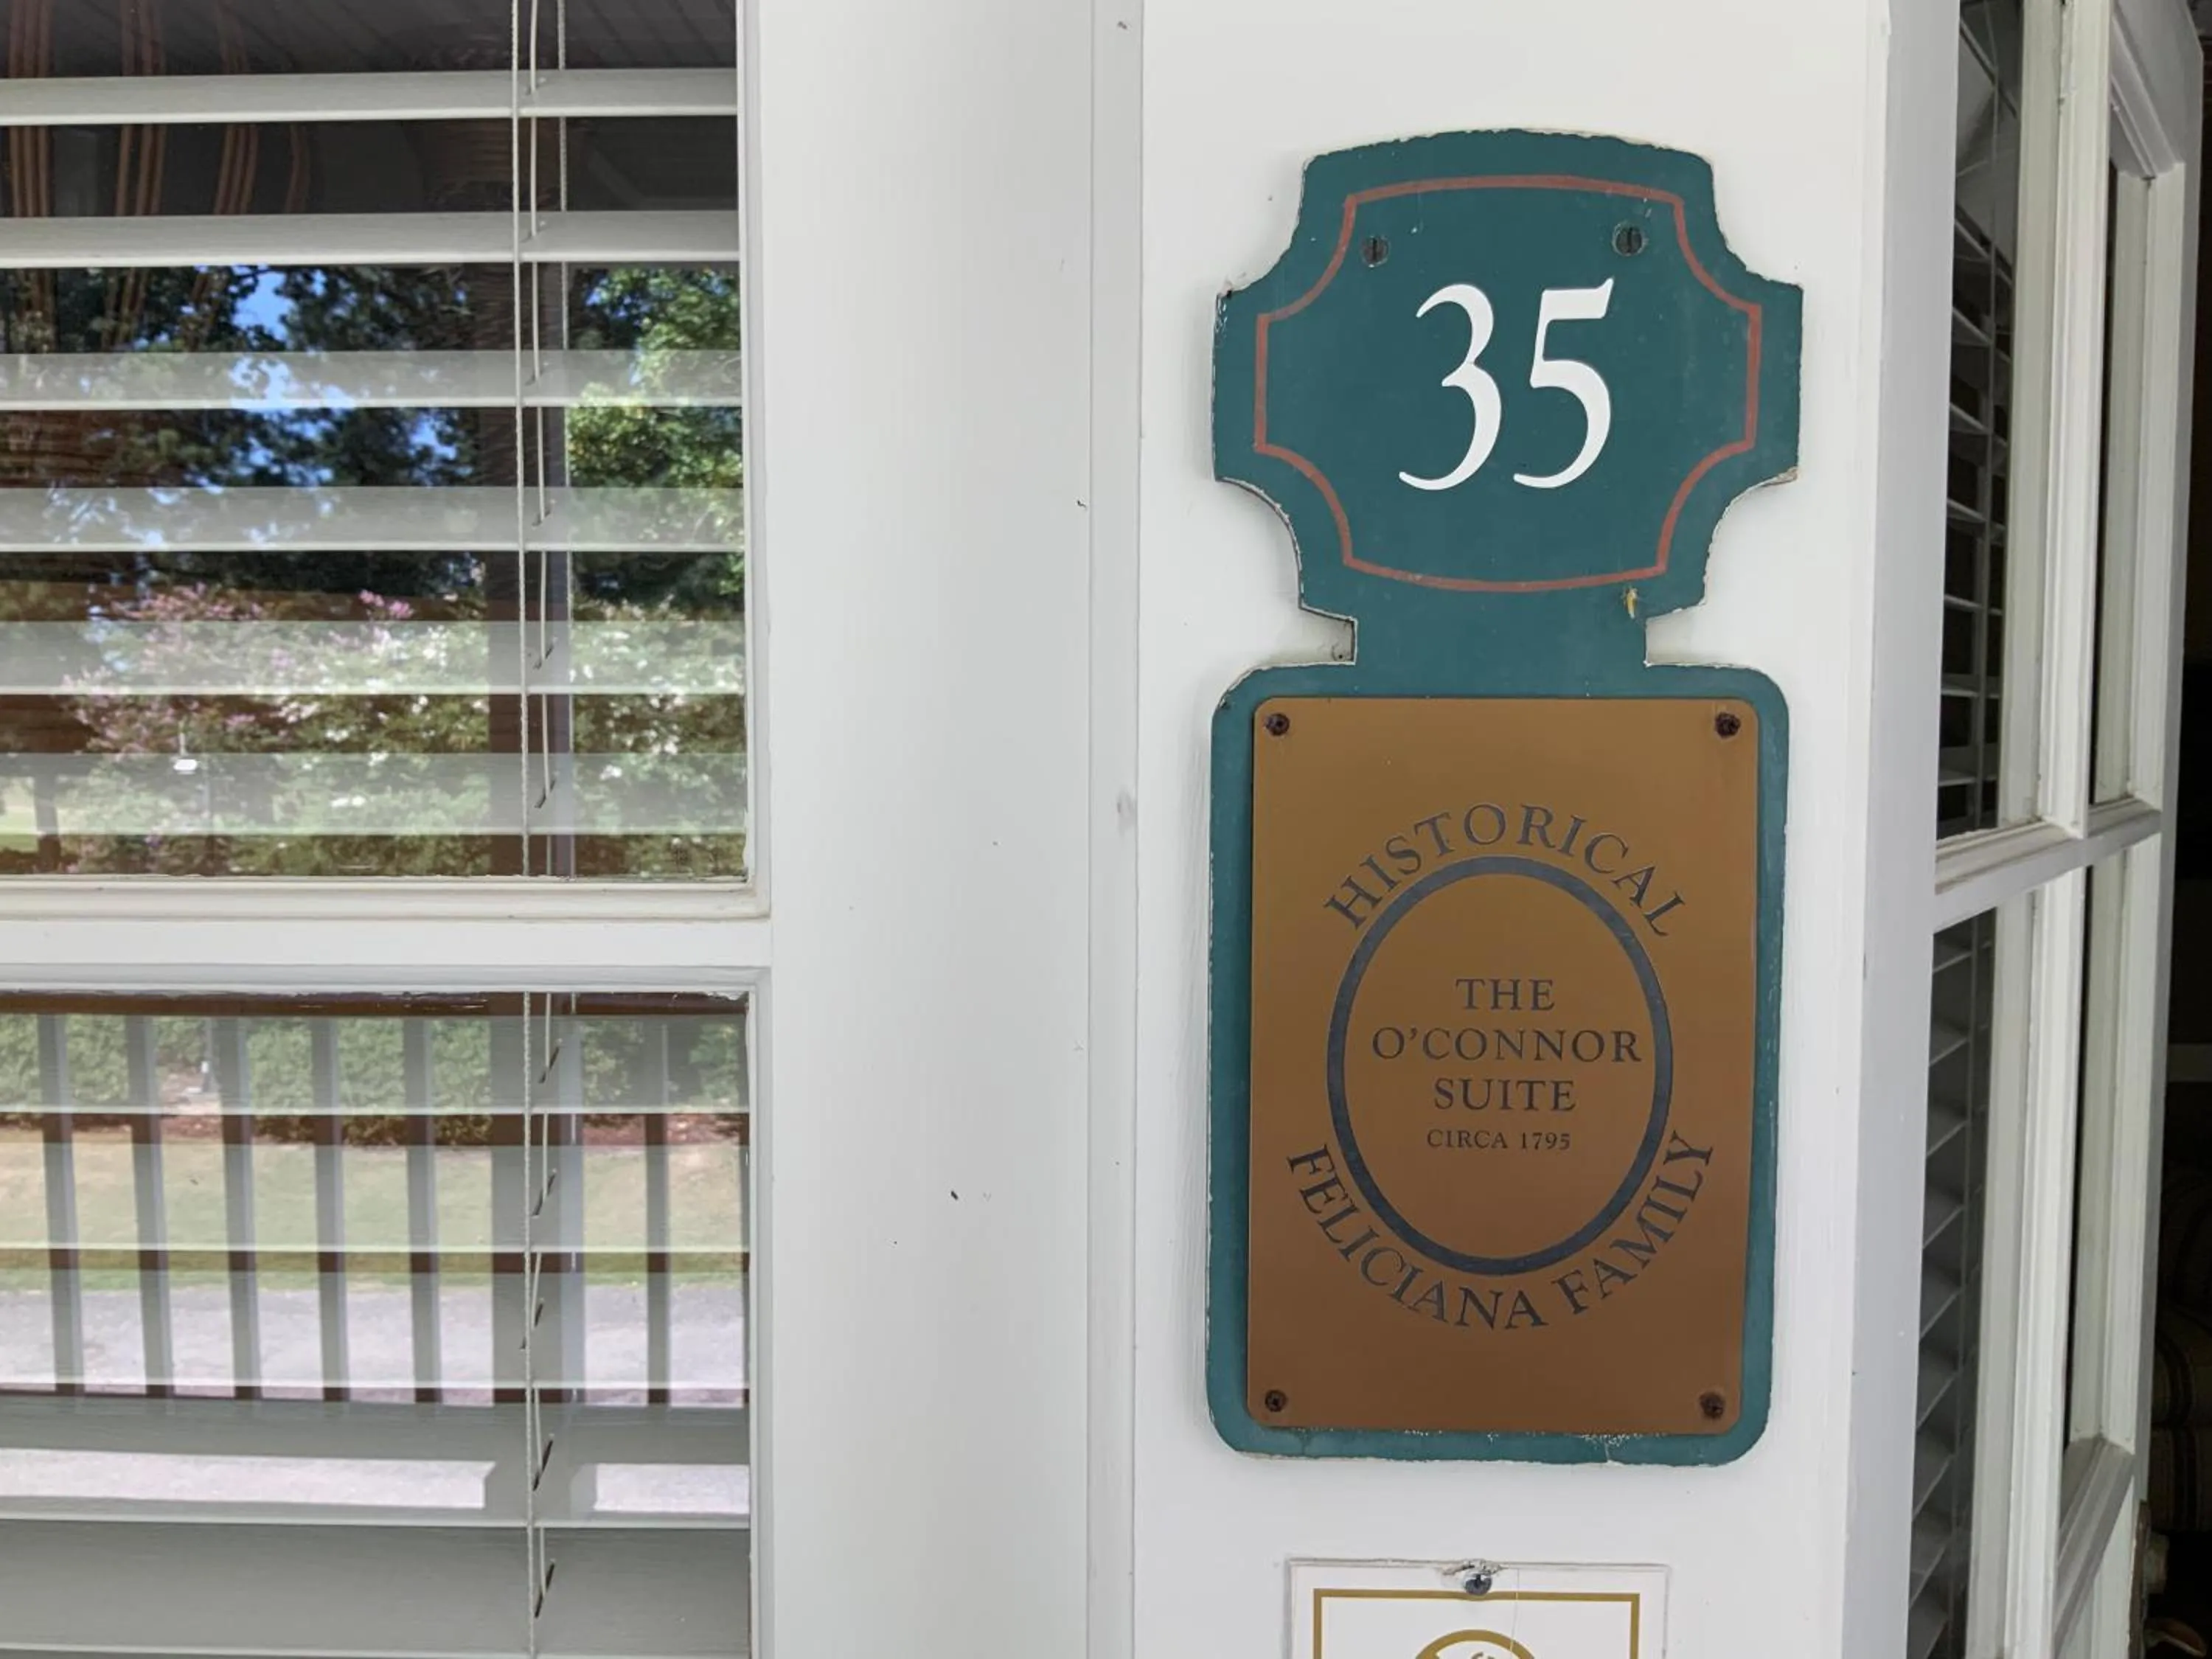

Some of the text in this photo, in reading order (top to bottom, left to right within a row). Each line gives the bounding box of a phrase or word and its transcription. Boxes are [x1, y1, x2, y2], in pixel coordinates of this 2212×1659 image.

[1399, 276, 1614, 490] 35
[1323, 803, 1686, 936] HISTORICAL
[1455, 978, 1555, 1011] THE
[1433, 1077, 1576, 1112] SUITE
[1427, 1129, 1571, 1151] CIRCA 1795
[1287, 1130, 1714, 1329] FELICIANA FAMILY
